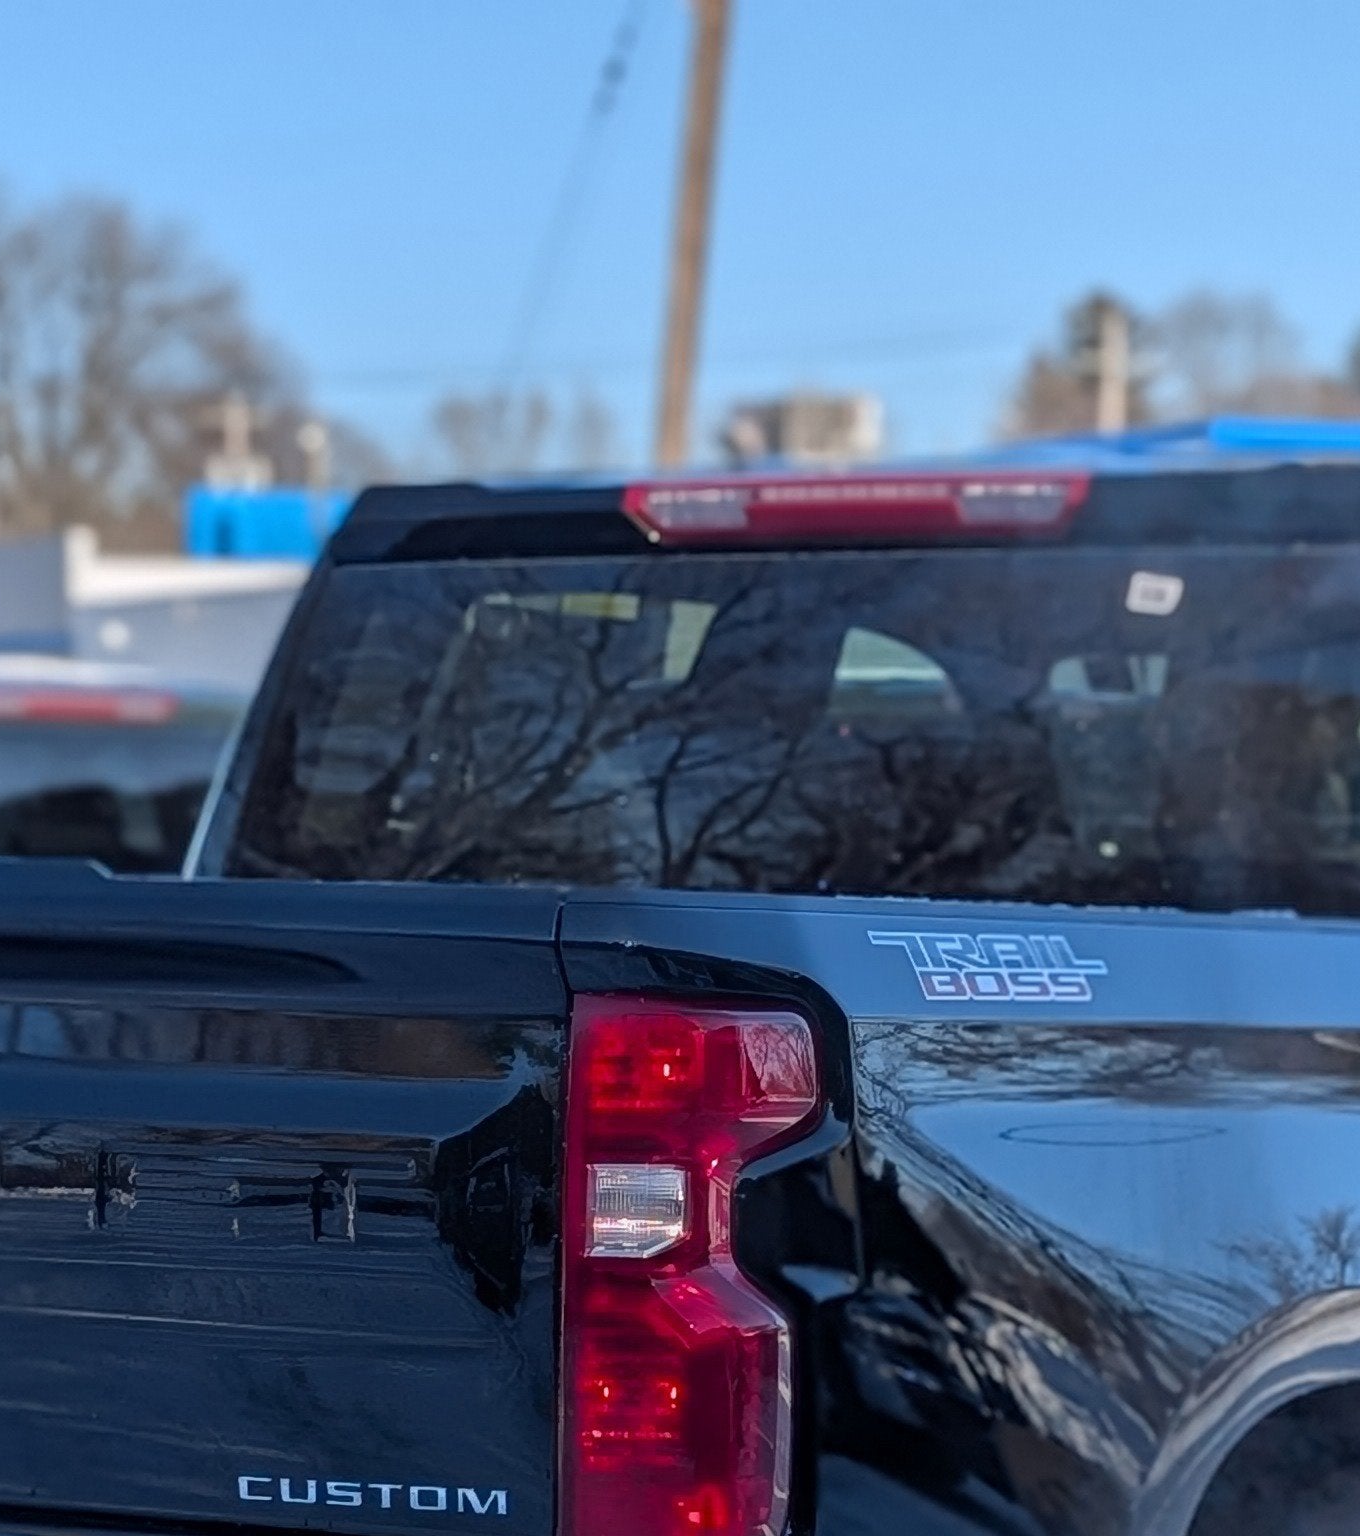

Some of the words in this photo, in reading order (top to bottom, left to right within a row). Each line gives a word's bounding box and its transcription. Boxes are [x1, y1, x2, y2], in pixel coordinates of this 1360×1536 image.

[867, 930, 1108, 974] TRAIL
[917, 967, 1092, 1001] BOSS
[237, 1476, 508, 1515] CUSTOM
